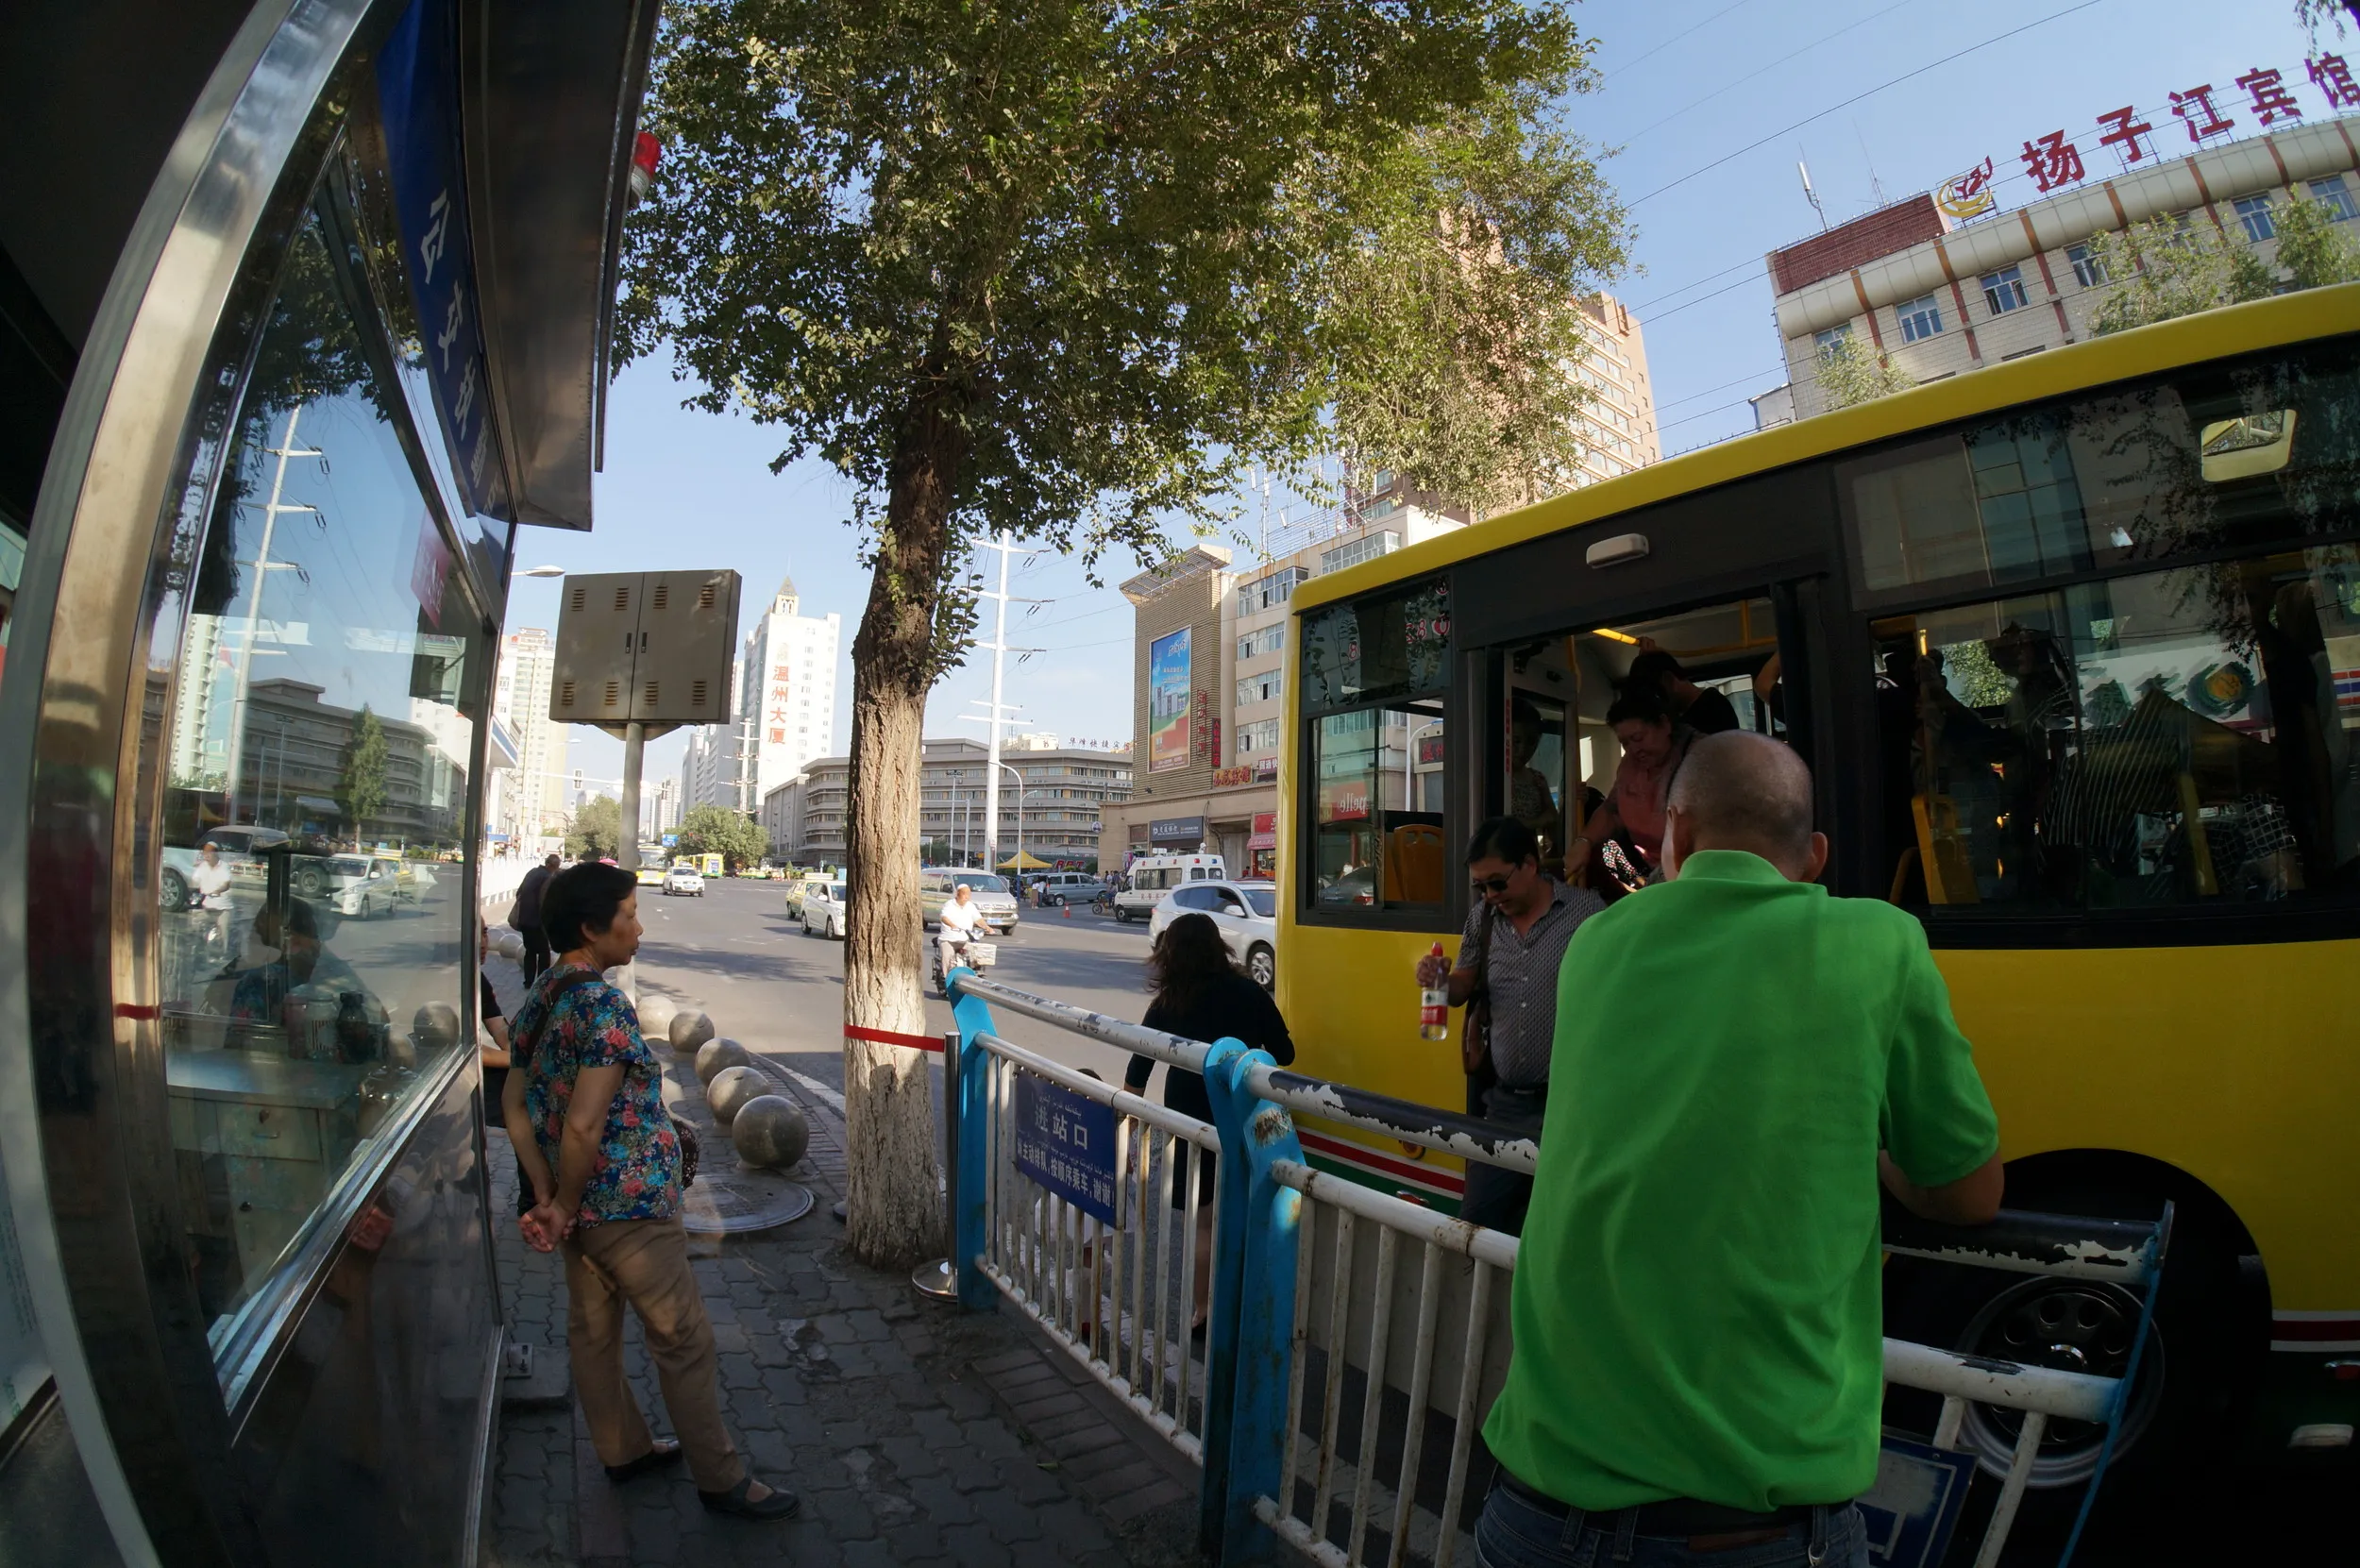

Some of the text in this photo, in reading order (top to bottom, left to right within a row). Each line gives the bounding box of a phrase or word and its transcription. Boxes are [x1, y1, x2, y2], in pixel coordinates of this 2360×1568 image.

[2020, 50, 2360, 194] 扬子江宾馆
[768, 665, 790, 746] 温州大厦
[1035, 1103, 1087, 1150] 进站口
